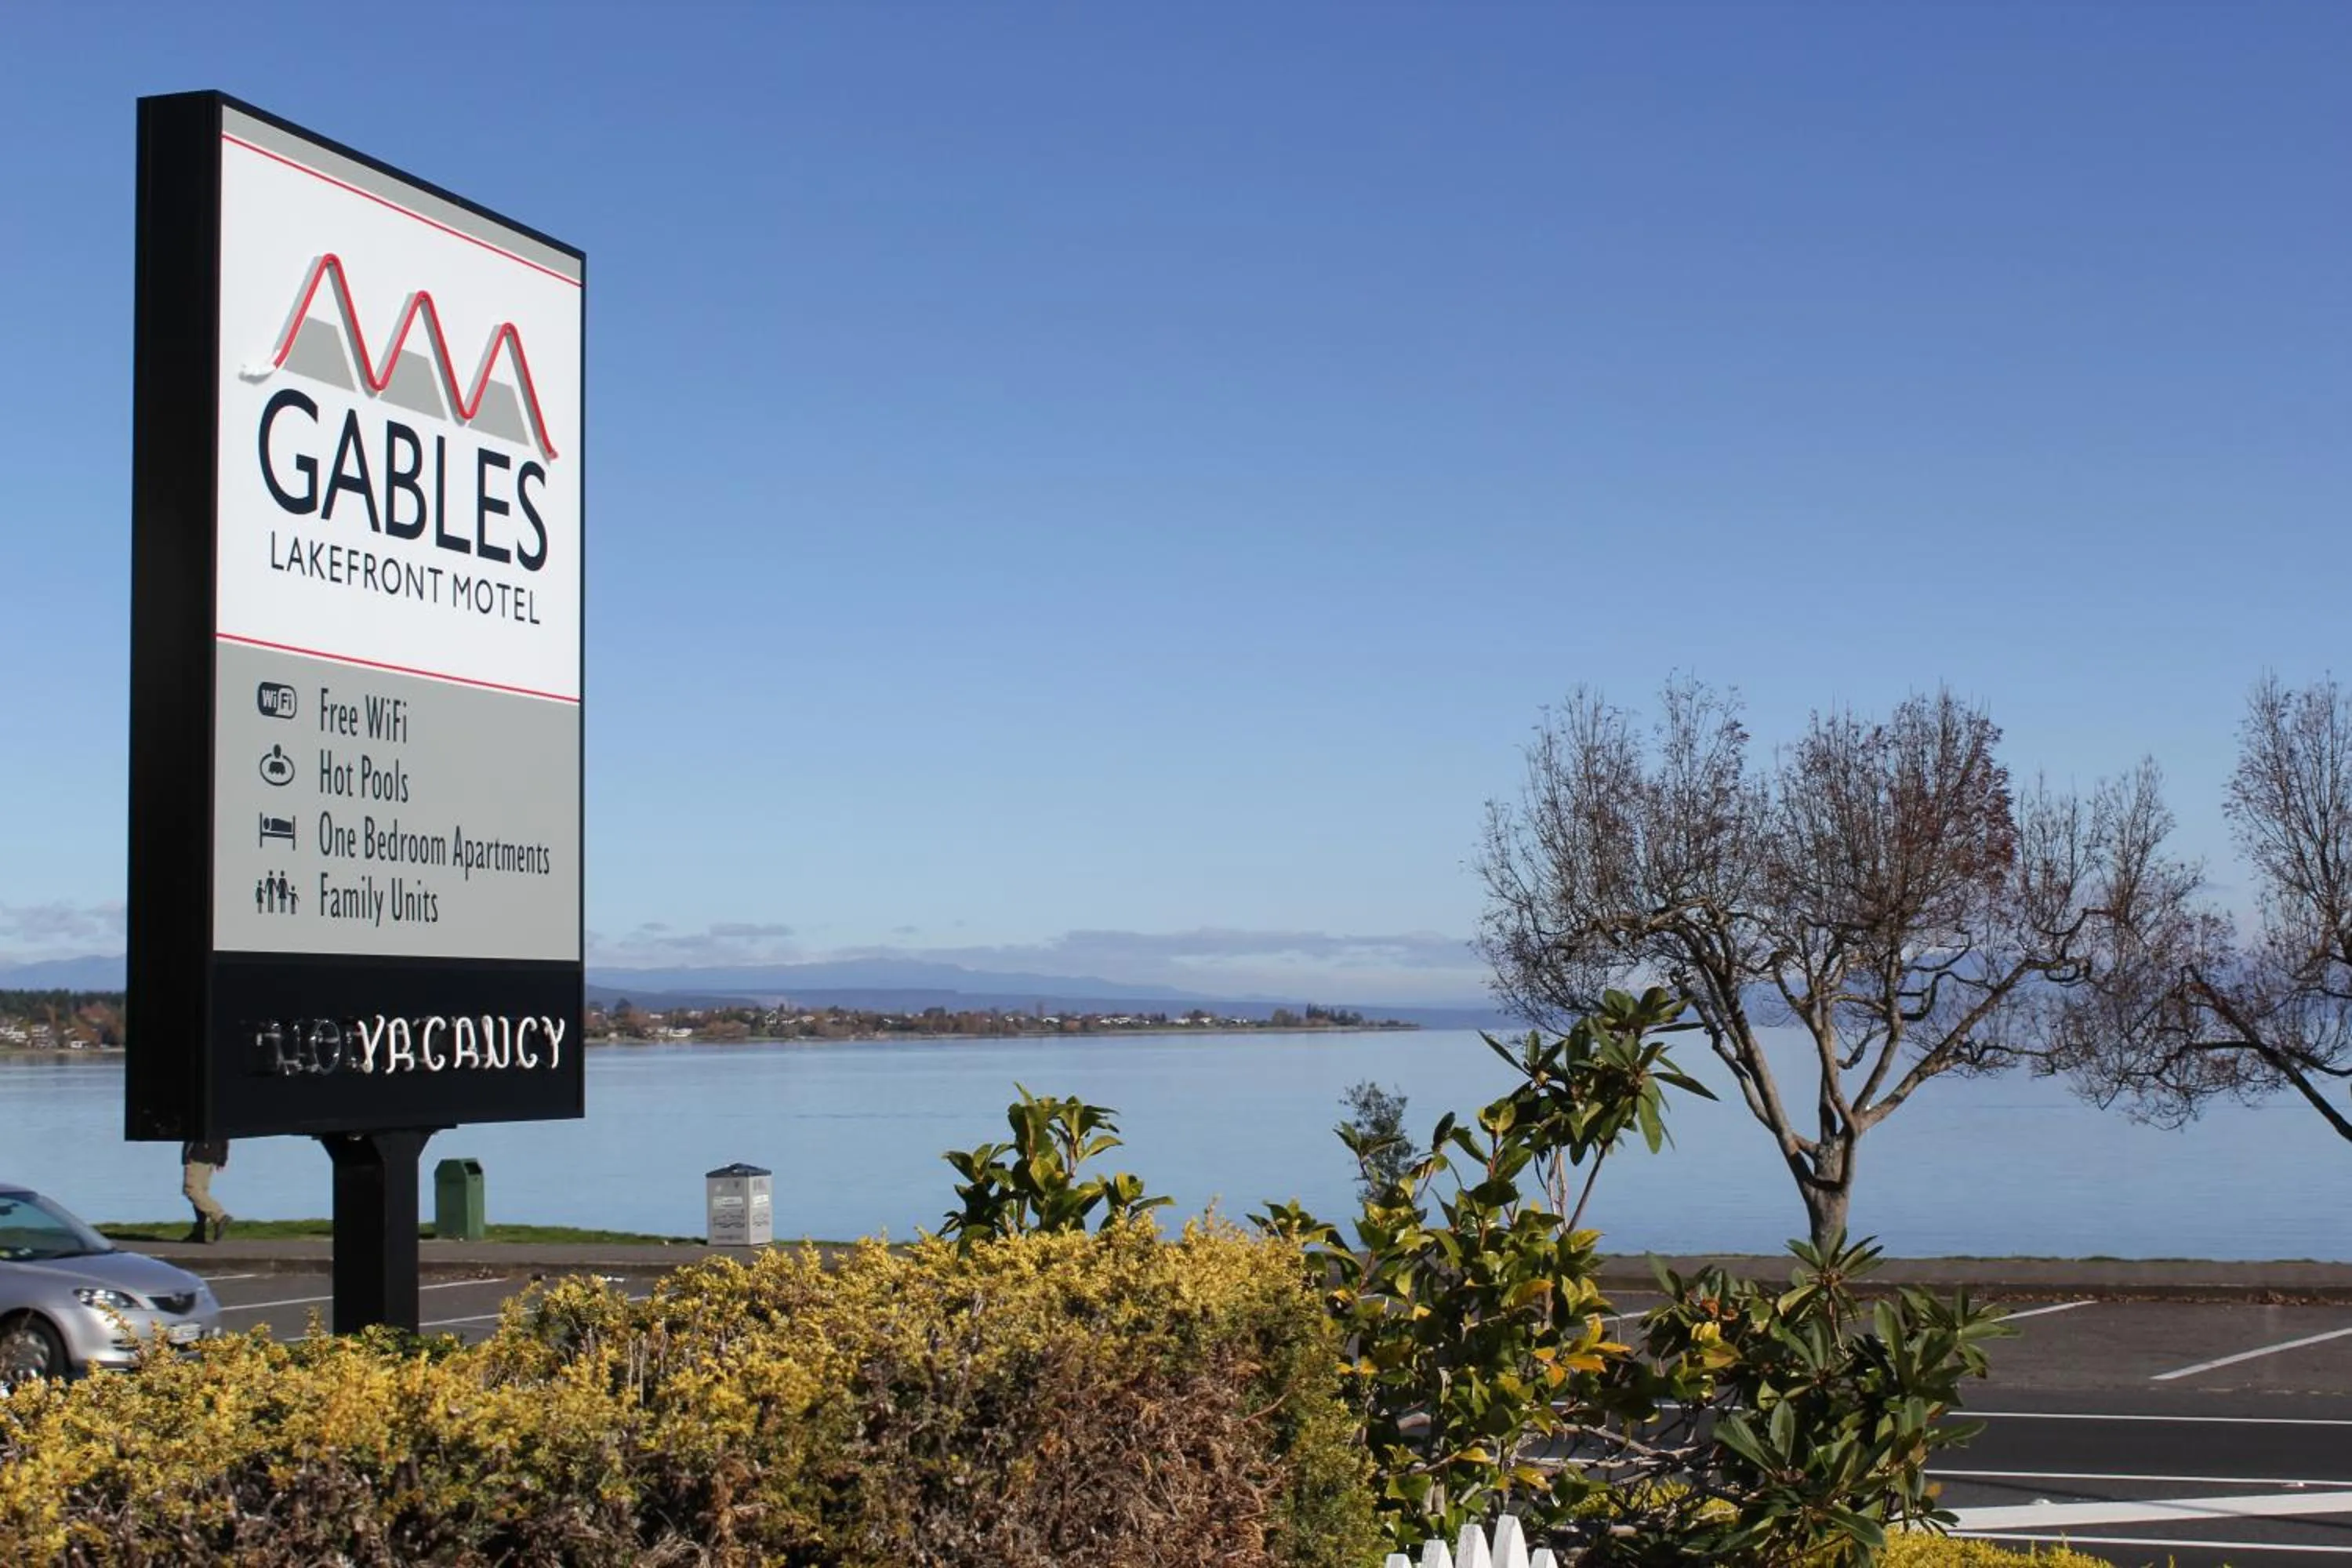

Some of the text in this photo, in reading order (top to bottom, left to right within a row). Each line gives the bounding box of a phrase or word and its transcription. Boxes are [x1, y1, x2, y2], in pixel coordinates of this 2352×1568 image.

[259, 388, 548, 572] GABLES
[270, 531, 540, 625] LAKEFRONT MOTEL
[320, 688, 408, 743] Free WiFi
[320, 750, 408, 803] Hot Pools
[319, 811, 550, 880] One Bedroom Apartments
[321, 873, 439, 927] Family Units
[357, 1014, 565, 1074] VACANCY
